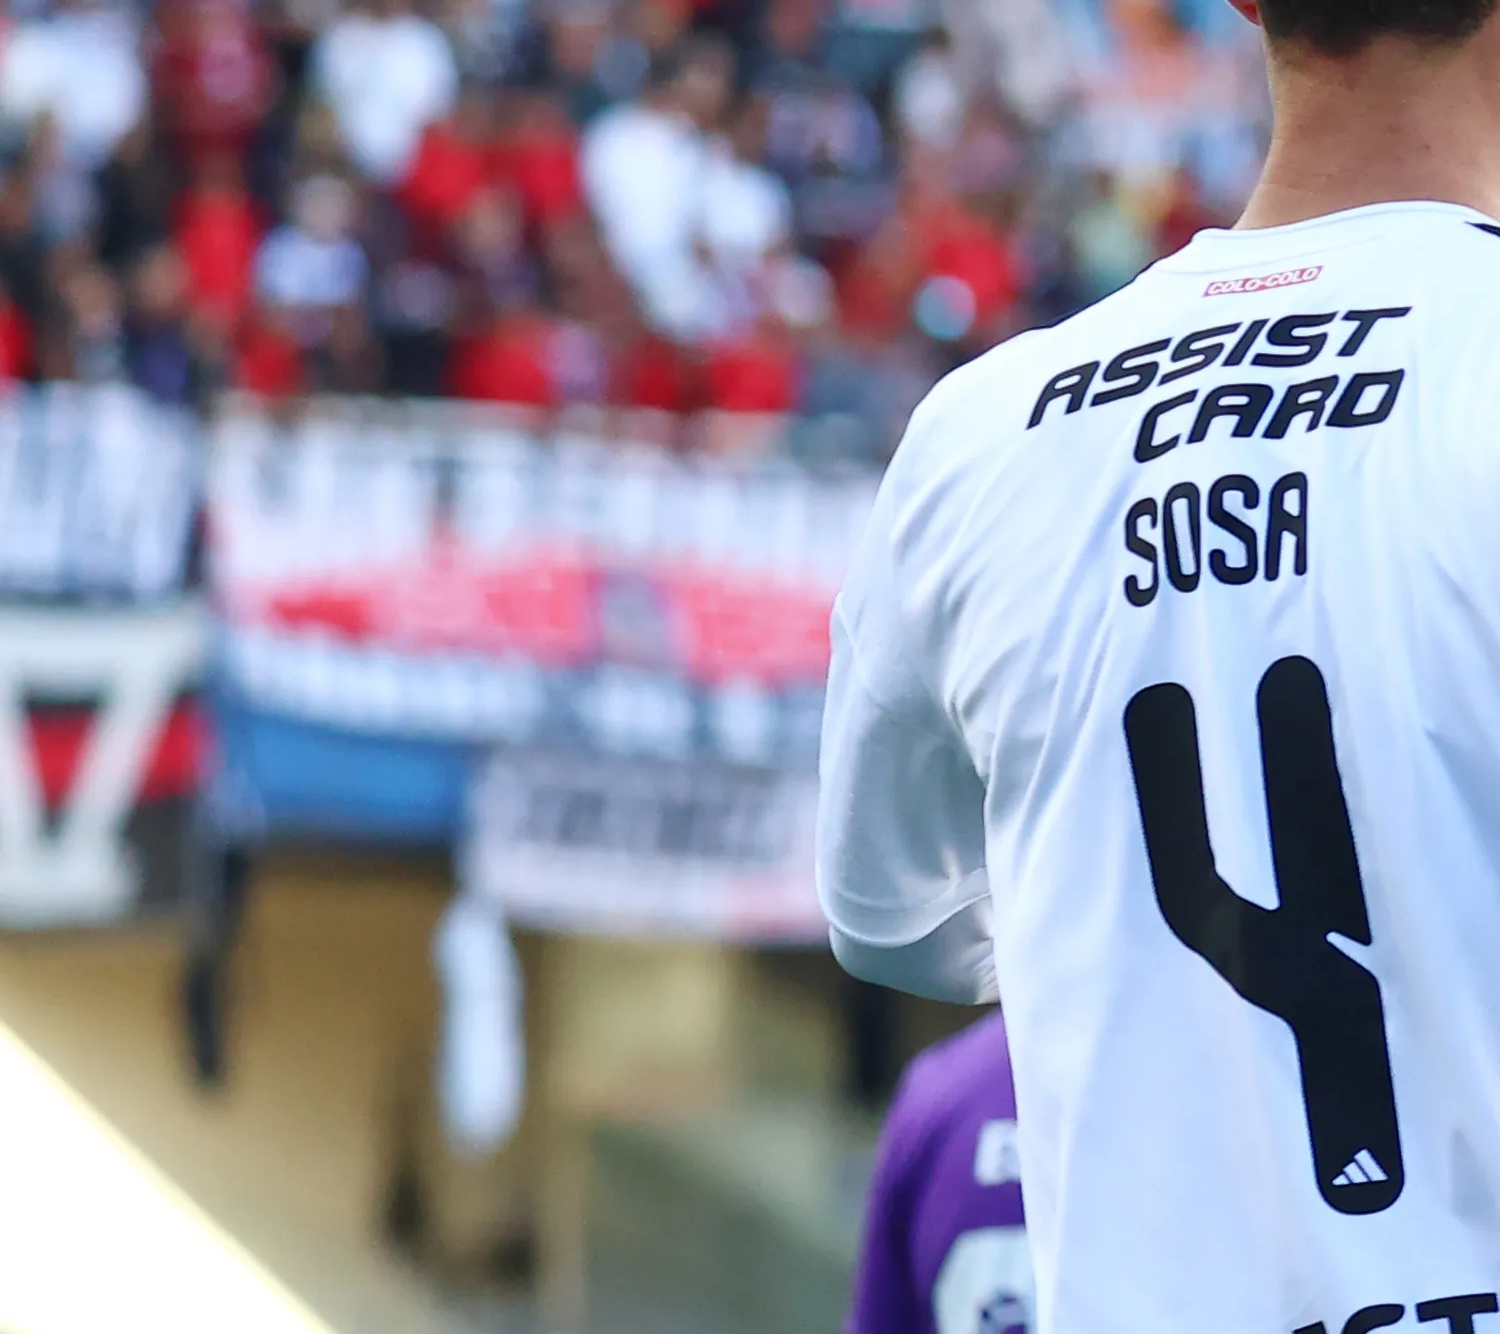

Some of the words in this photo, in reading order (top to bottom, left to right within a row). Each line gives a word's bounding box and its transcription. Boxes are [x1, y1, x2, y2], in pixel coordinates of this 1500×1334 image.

[1207, 267, 1319, 295] COLO-COLO
[1027, 306, 1412, 429] ASSIST
[1134, 368, 1405, 463] CARD
[1123, 471, 1308, 607] SOSA
[1123, 655, 1405, 1215] 4
